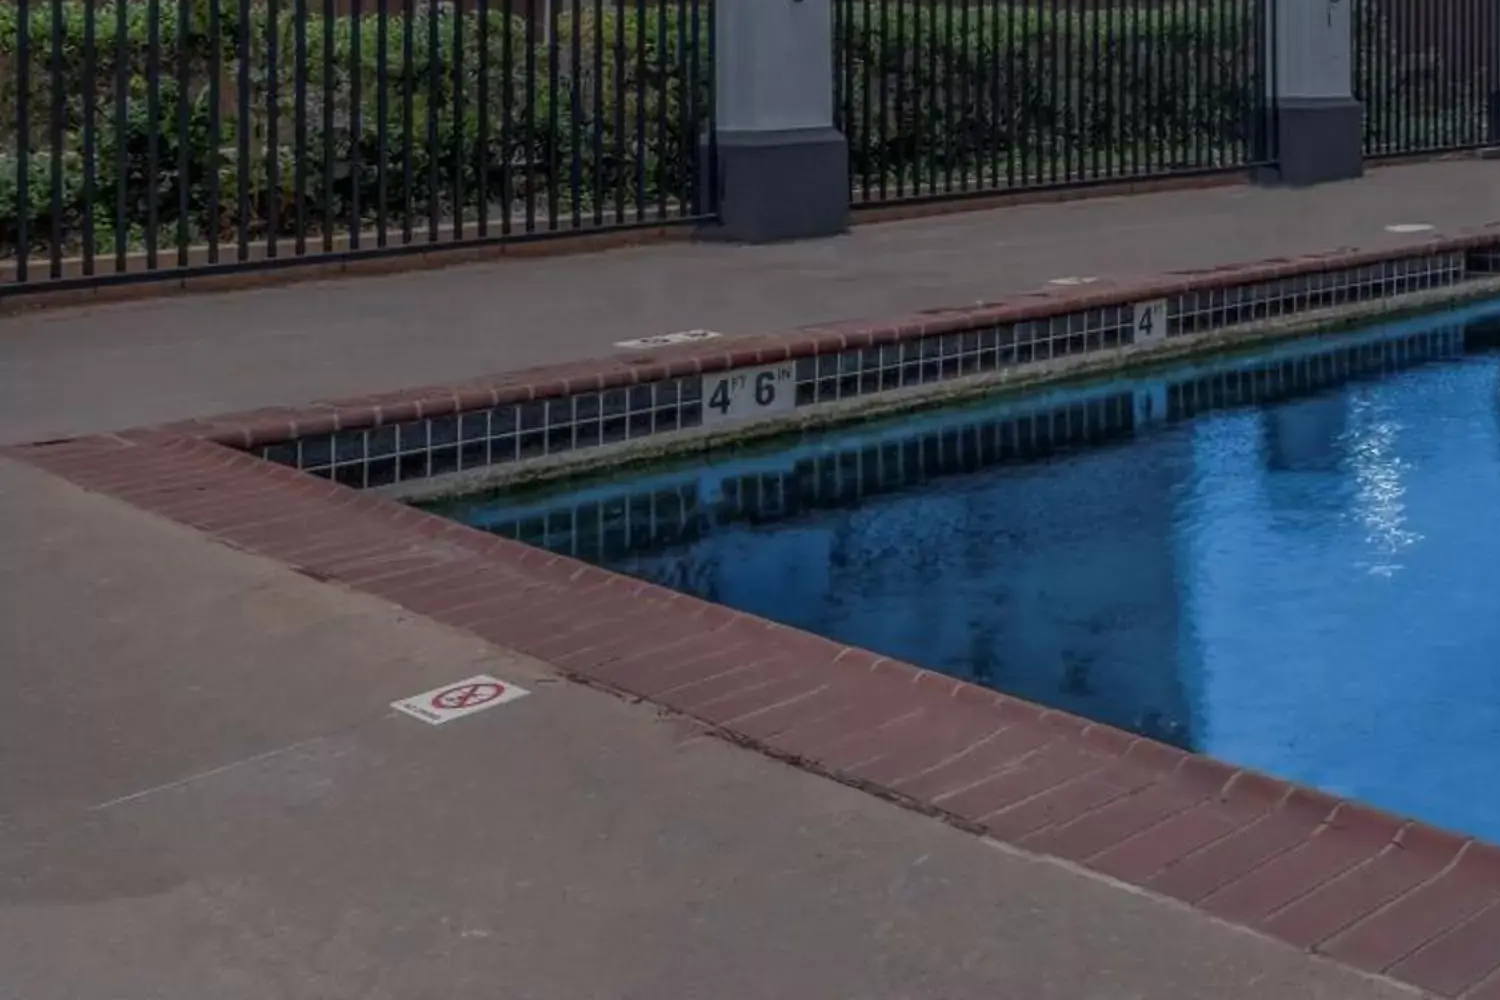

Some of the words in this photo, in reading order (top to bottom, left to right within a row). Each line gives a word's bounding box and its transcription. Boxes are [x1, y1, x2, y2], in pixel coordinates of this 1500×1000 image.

[1139, 306, 1153, 336] 4
[708, 379, 731, 415] 4
[755, 371, 776, 406] 6
